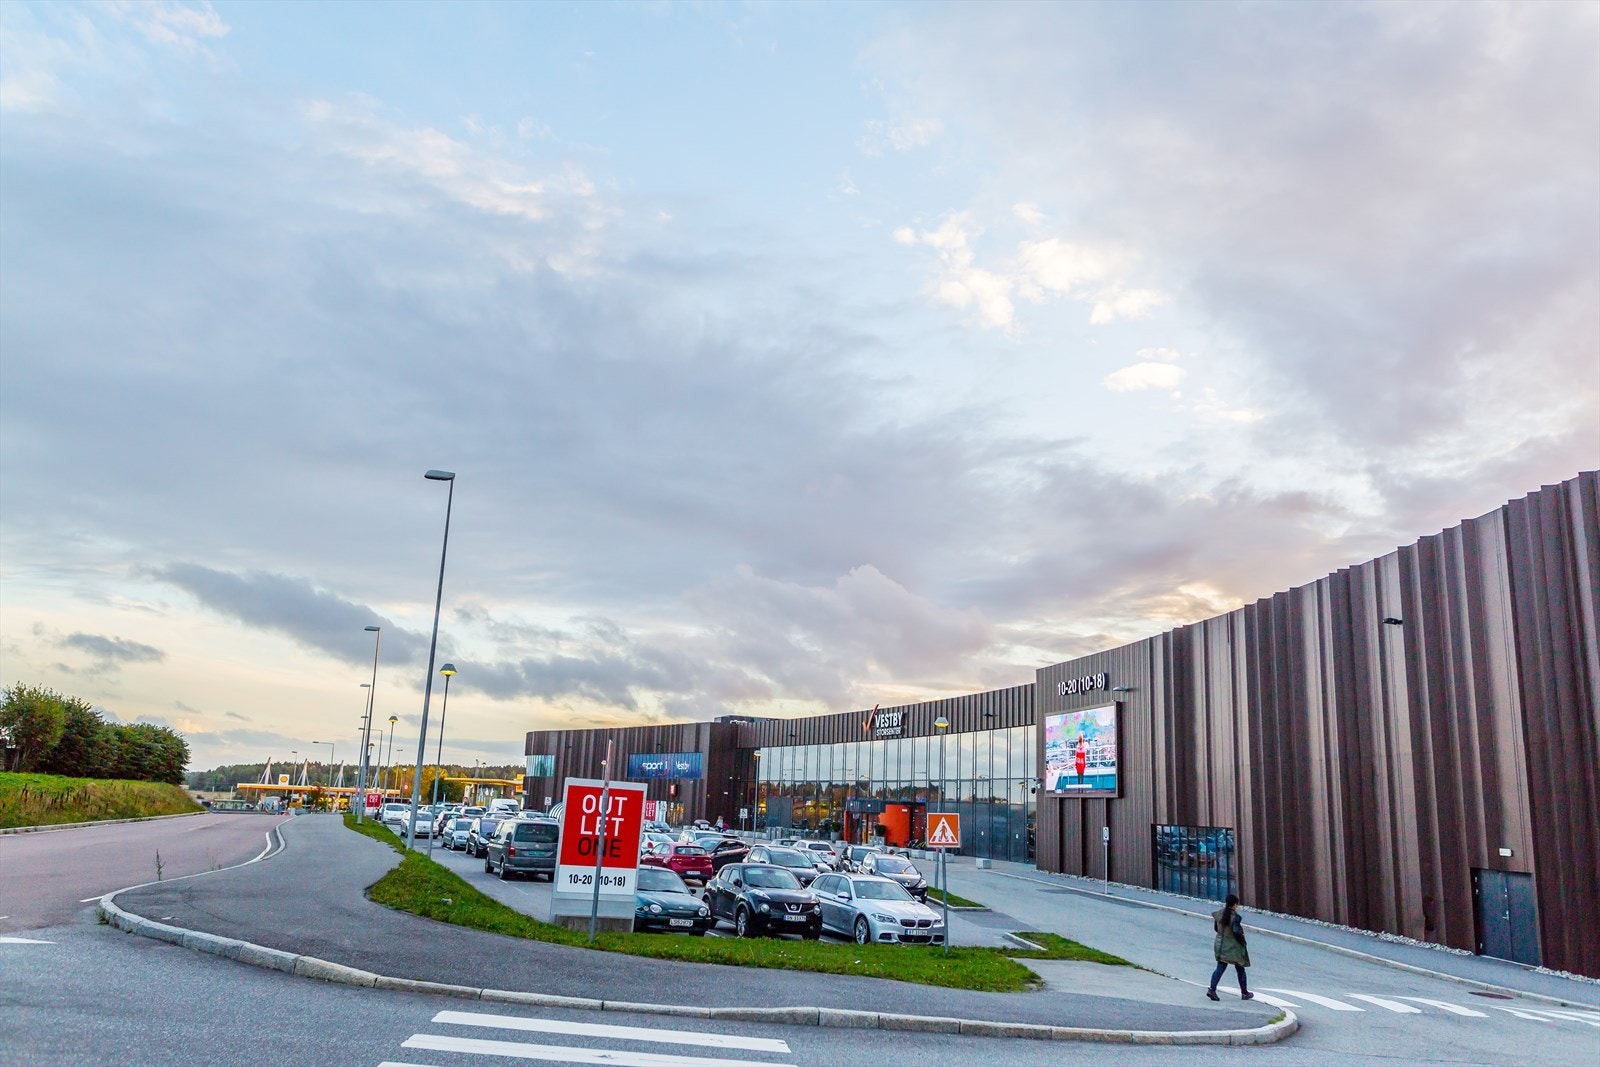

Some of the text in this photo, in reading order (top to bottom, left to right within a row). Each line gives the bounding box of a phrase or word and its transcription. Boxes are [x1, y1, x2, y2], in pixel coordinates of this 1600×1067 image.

[1058, 672, 1105, 696] 10-20 (10-18)
[875, 712, 903, 728] VESTBY
[642, 761, 663, 771] sport
[582, 794, 628, 816] OUT
[580, 815, 625, 837] LET
[577, 837, 622, 858] ONE
[568, 874, 626, 887] 10-20 10-18)
